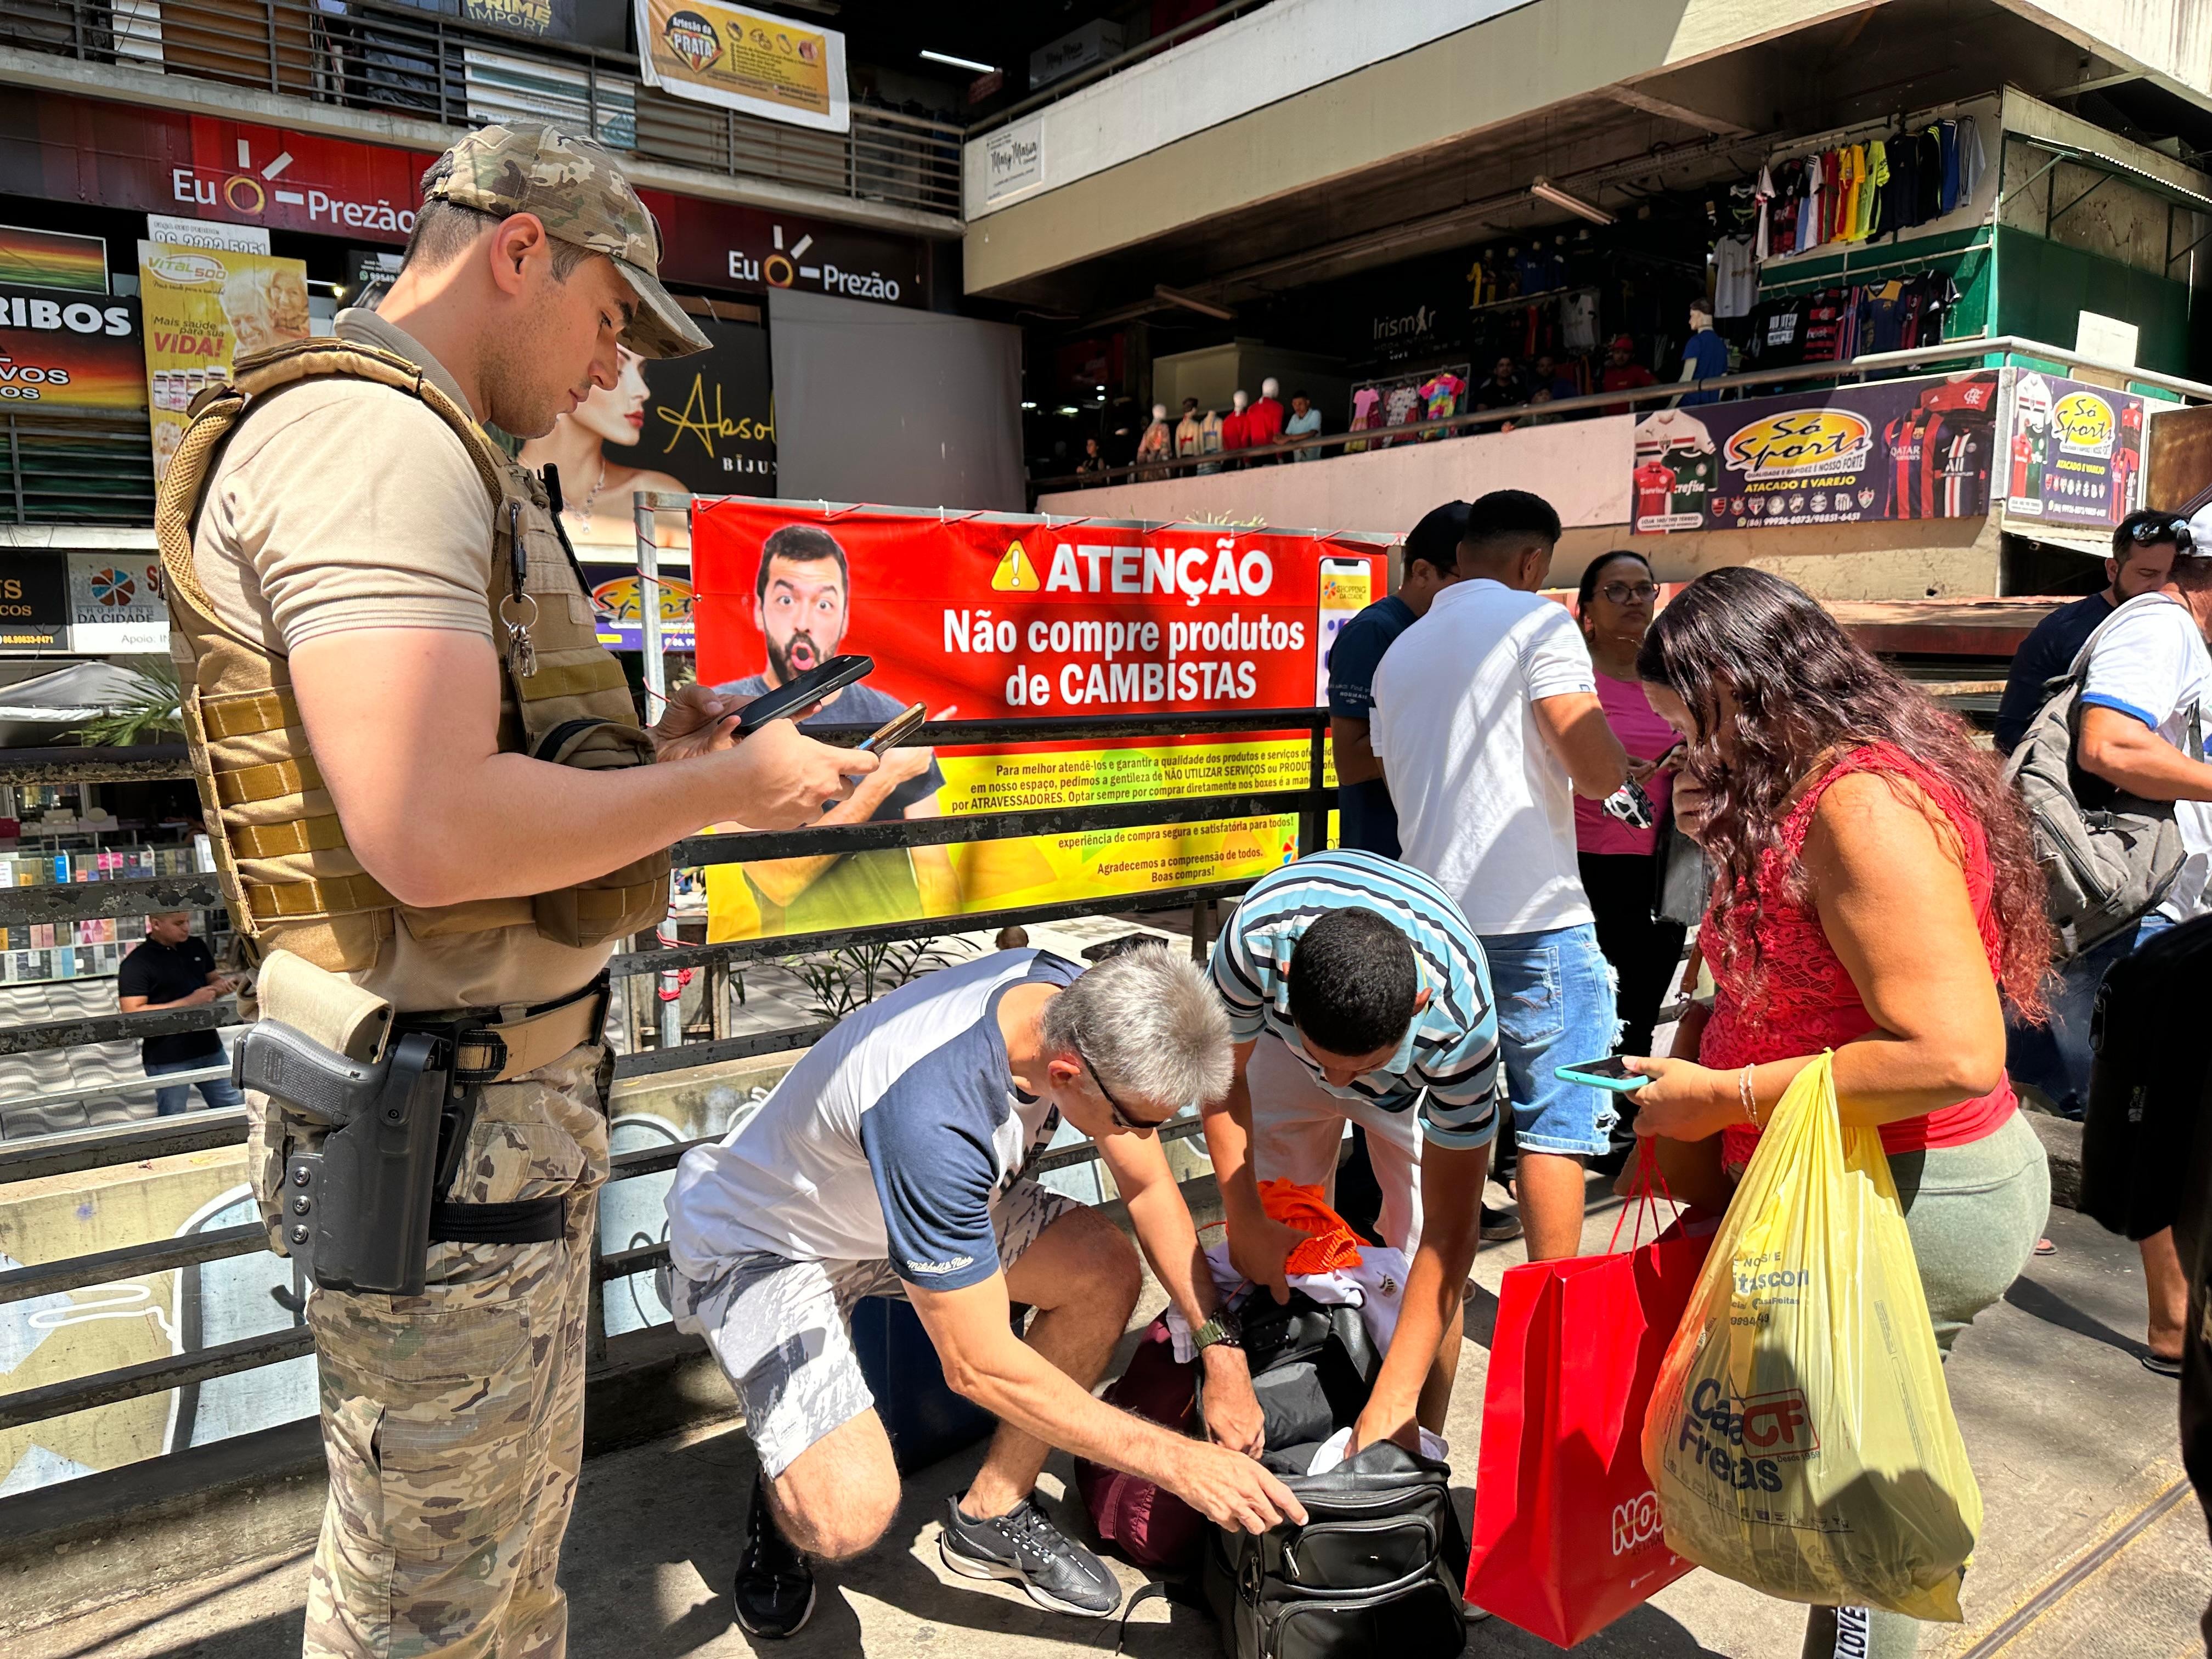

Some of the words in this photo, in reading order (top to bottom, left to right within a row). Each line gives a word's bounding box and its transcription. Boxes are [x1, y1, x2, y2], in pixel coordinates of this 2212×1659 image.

[469, 7, 549, 36] IMPORT
[673, 33, 713, 57] PRATA
[173, 169, 217, 205] Eu
[308, 189, 415, 234] Prezão
[729, 250, 759, 281] Eu
[823, 264, 900, 301] Prezão
[154, 316, 179, 328] Mais
[183, 319, 217, 330] saúde
[179, 328, 204, 337] para
[206, 330, 224, 338] sua
[154, 332, 223, 358] VIDA!
[2074, 398, 2097, 417] Só
[1770, 417, 1822, 440] Só
[1730, 431, 1869, 472] Sports
[1890, 445, 1921, 457] QATAR
[1818, 460, 1842, 473] NOSSO
[1843, 453, 1864, 470] FORTE
[1744, 479, 1798, 493] ATACADO
[1801, 478, 1808, 489] E
[1810, 476, 1856, 488] VAREJO
[1045, 538, 1273, 607] ATENÇÃO
[1336, 585, 1367, 594] SHOPPING
[76, 605, 154, 615] SHOPPING
[78, 613, 98, 624] DA
[101, 613, 154, 624] CIDADE
[121, 634, 157, 645] Apoio:
[944, 610, 1017, 653] Não
[1027, 620, 1160, 661] compre
[1168, 612, 1305, 661] produtos
[1006, 664, 1051, 706] de
[1059, 661, 1257, 705] CAMBISTAS
[996, 764, 1020, 777] Para
[1022, 763, 1057, 775] melhor
[1058, 759, 1107, 774] atendê-los
[1109, 761, 1115, 769] e
[1116, 758, 1152, 770] garantir
[1154, 758, 1159, 766] a
[1161, 753, 1205, 769] qualidade
[1206, 752, 1221, 764] dos
[1222, 751, 1259, 765] produtos
[1261, 752, 1266, 761] e
[1267, 749, 1300, 761] serviços
[970, 784, 986, 794] em
[989, 782, 1018, 793] nosso
[1019, 780, 1058, 793] espaço,
[1059, 776, 1101, 792] pedimos
[1102, 777, 1108, 785] a
[1110, 771, 1150, 787] gentileza
[1152, 770, 1163, 781] de
[1164, 768, 1182, 781] NÃO
[1184, 766, 1222, 780] UTILIZAR
[1224, 764, 1266, 777] SERVIÇOS
[1267, 765, 1277, 774] ou
[952, 801, 969, 813] por
[970, 792, 1066, 810] ATRAVESSADORES.
[1068, 791, 1095, 803] Optar
[1096, 789, 1130, 802] sempre
[1132, 787, 1148, 799] por
[1149, 785, 1186, 798] comprar
[1187, 780, 1237, 794] diretamente
[1238, 781, 1253, 790] nos
[1254, 776, 1278, 788] boxes
[1279, 775, 1284, 786] é
[1058, 832, 1112, 849] experiência
[1114, 832, 1125, 843] de
[1127, 830, 1160, 845] compra
[1162, 827, 1191, 840] segura
[1193, 826, 1199, 835] e
[1200, 820, 1247, 836] satisfatória
[1249, 821, 1267, 833] para
[1269, 816, 1294, 829] todos!
[1097, 857, 1159, 874] Agradecemos
[1160, 859, 1166, 867] a
[1167, 851, 1224, 869] compreensão
[1226, 850, 1237, 861] de
[1238, 847, 1263, 860] todos.
[1152, 870, 1173, 883] Boas
[1175, 865, 1215, 882] compras!
[906, 1260, 944, 1272] Mitchell
[951, 1256, 974, 1268] Ness
[1776, 1454, 1801, 1463] Desde
